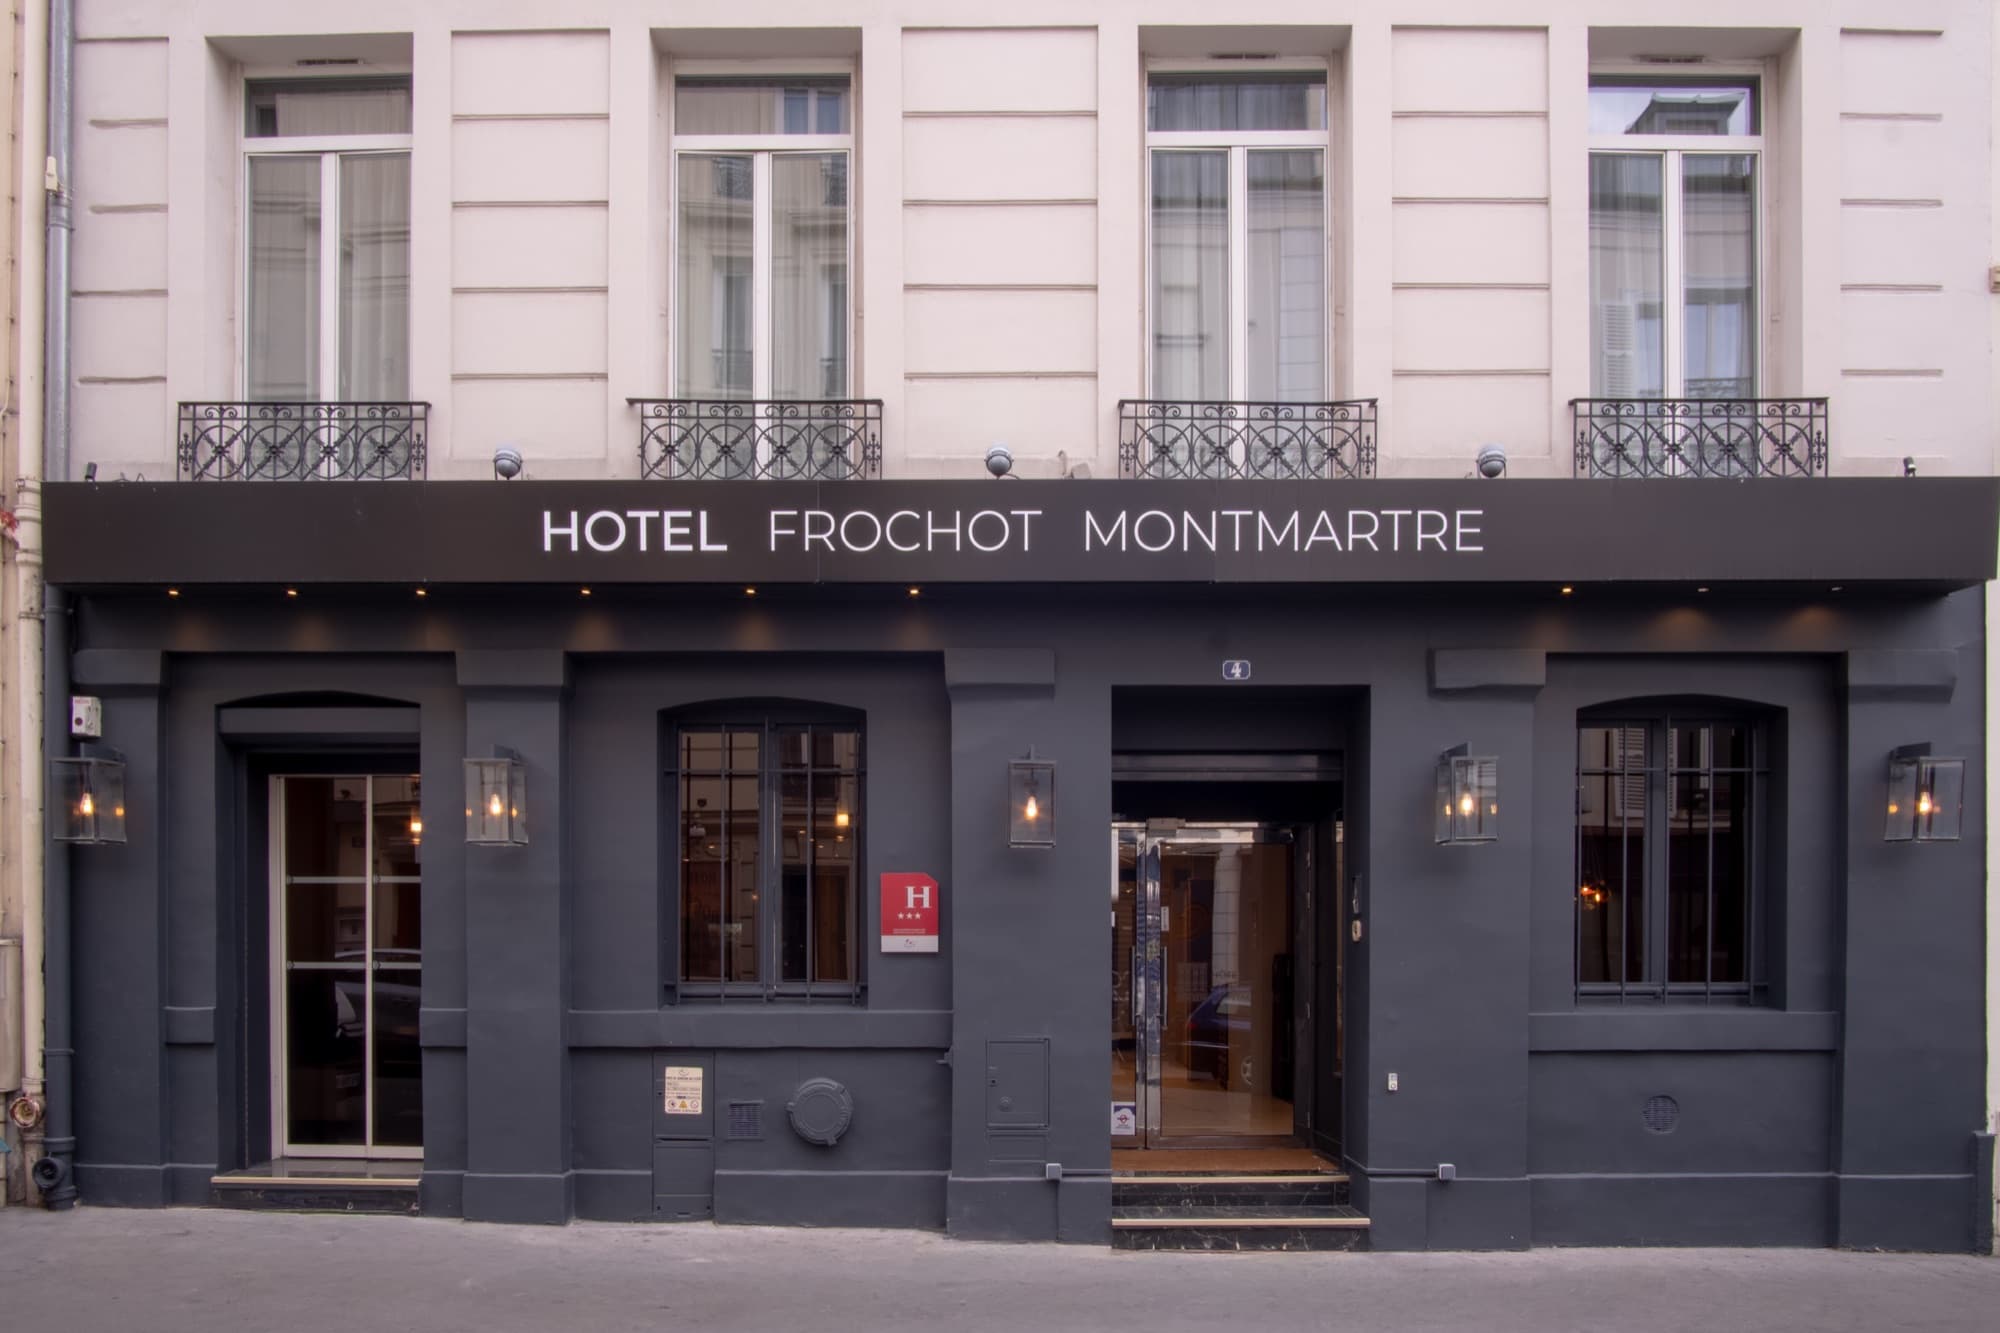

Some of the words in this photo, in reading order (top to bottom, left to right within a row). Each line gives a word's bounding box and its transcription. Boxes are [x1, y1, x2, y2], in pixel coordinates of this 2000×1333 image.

[543, 510, 728, 552] HOTEL
[770, 510, 1043, 552] FROCHOT
[1085, 509, 1484, 552] MONTMARTRE
[1231, 662, 1242, 678] 4
[904, 885, 932, 909] H
